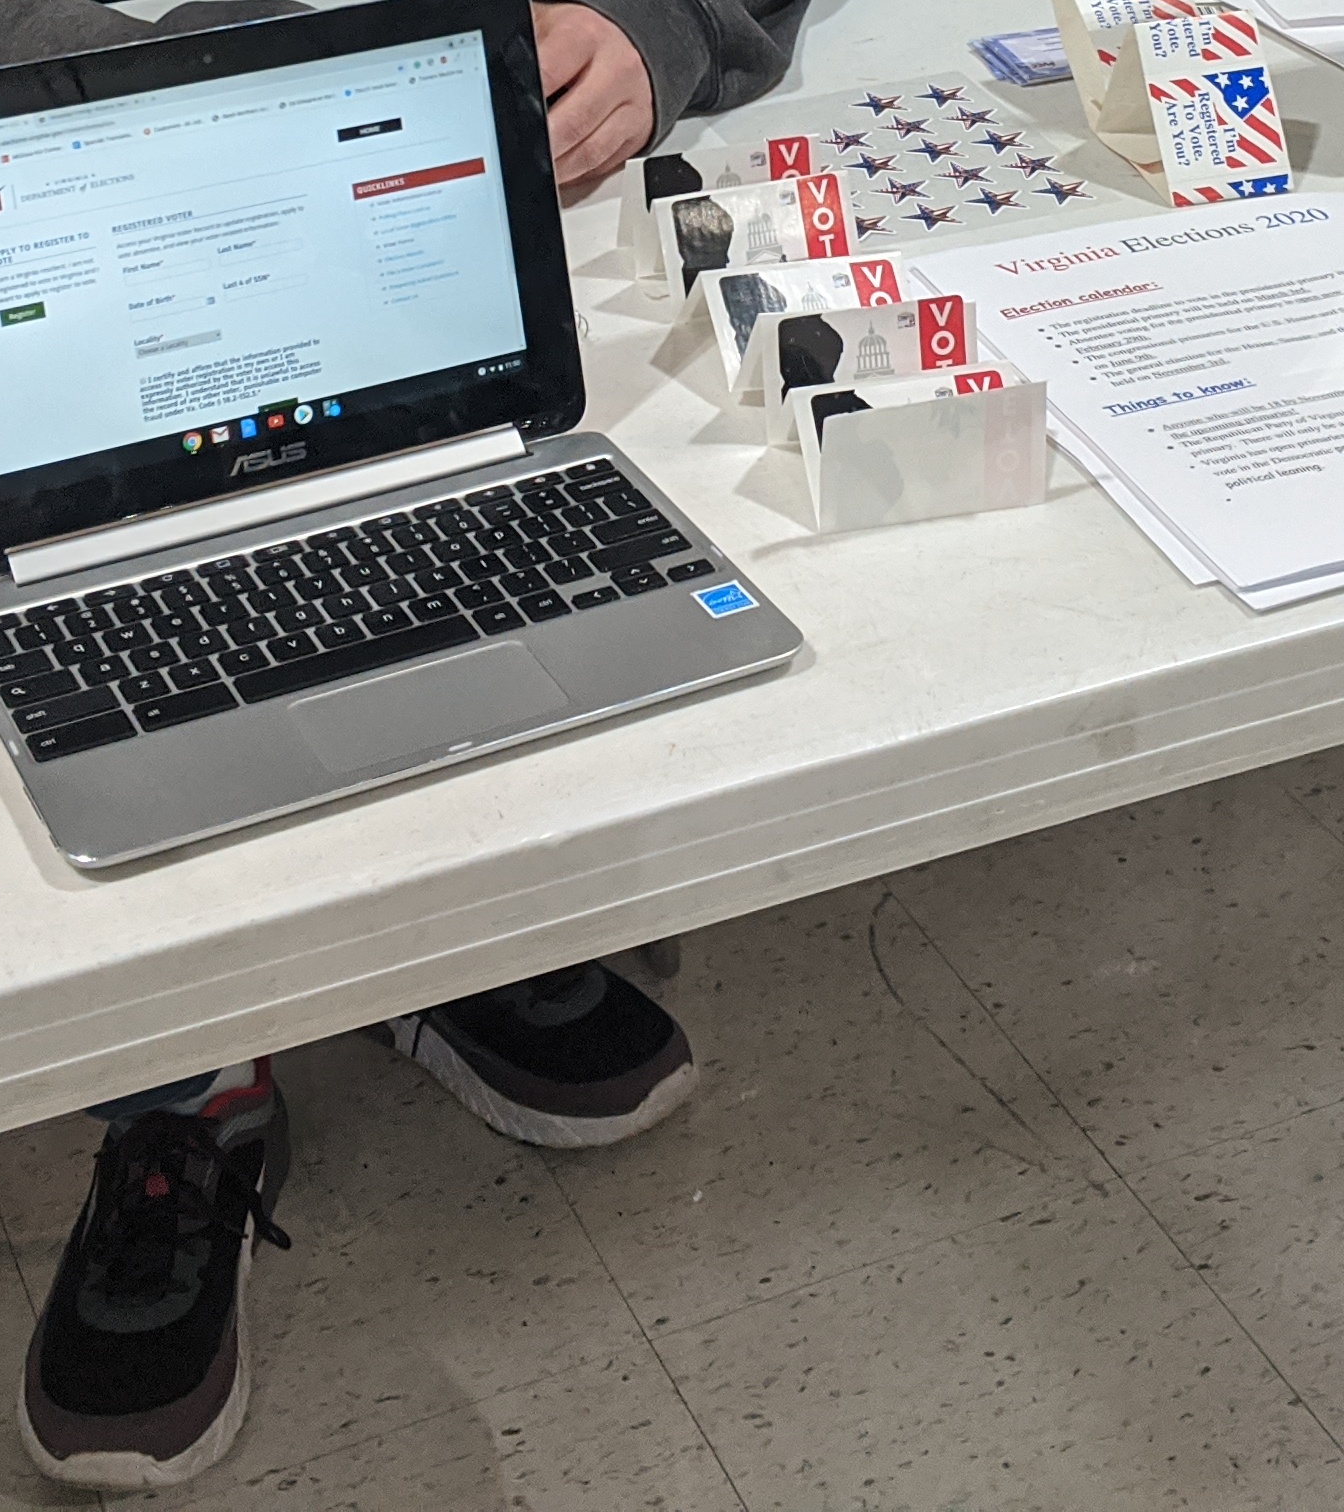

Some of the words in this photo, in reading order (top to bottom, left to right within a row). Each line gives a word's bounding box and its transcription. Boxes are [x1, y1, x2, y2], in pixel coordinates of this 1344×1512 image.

[1091, 1, 1112, 30] You?
[1199, 21, 1212, 45] I'm
[1149, 23, 1167, 58] You?
[1165, 101, 1178, 127] Are
[1173, 129, 1190, 166] You?
[1183, 101, 1194, 120] To
[1189, 125, 1203, 161] Vote.
[1198, 92, 1225, 166] Registered
[1223, 128, 1236, 153] I'm
[357, 178, 405, 195] QUICKLINKS
[111, 217, 163, 234] REGISTERED
[167, 210, 193, 221] VOTER
[807, 179, 835, 257] VOT
[994, 246, 1119, 274] Virginia
[1121, 218, 1255, 253] Elections
[1256, 208, 1328, 228] 2020
[1000, 298, 1074, 319] Election
[1075, 282, 1162, 304] calendar:
[1102, 396, 1170, 416] Things
[1170, 391, 1196, 403] to
[1196, 378, 1255, 398] know:
[228, 441, 306, 477] ASUS
